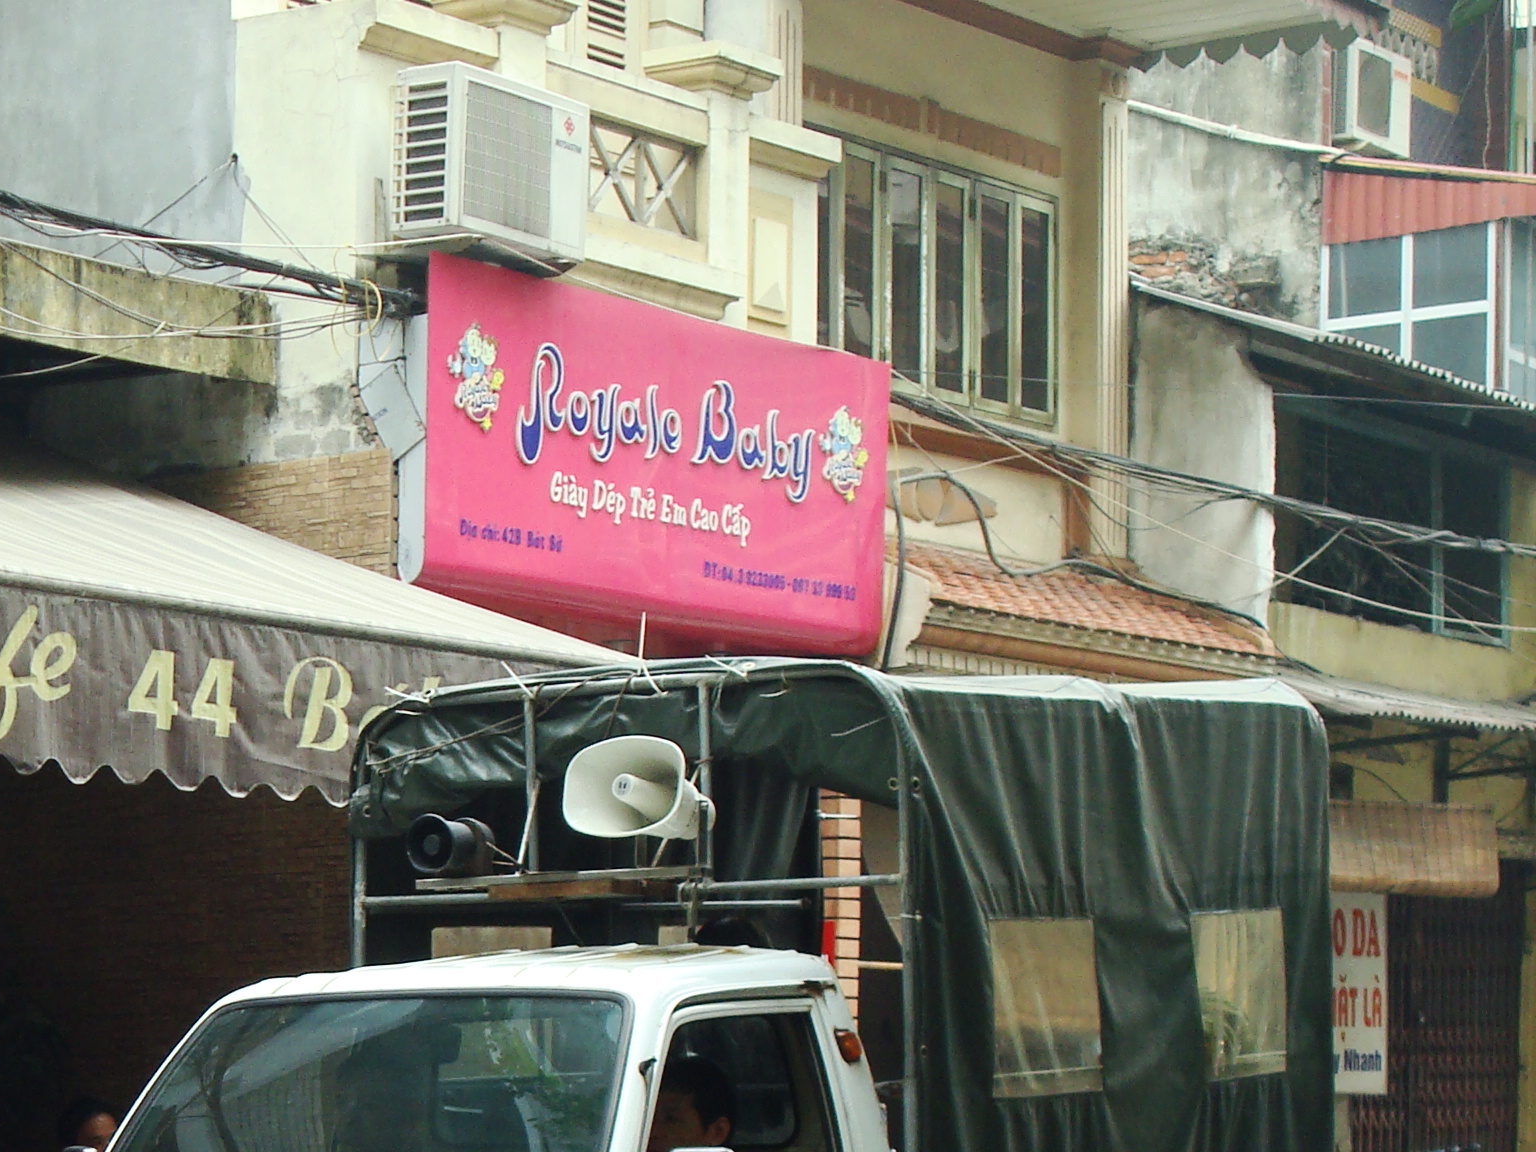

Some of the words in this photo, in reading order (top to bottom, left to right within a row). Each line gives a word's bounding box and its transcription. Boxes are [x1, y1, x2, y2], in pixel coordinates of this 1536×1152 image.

[516, 342, 682, 464] Royale
[690, 380, 816, 503] Baby
[550, 471, 588, 518] Giày
[591, 479, 626, 524] Dép
[630, 486, 657, 520] Trẻ
[660, 494, 687, 526] Em
[690, 498, 719, 532] Cao
[721, 503, 751, 547] Cấp
[128, 649, 239, 738] 44
[1352, 908, 1381, 958] DA
[1363, 973, 1382, 1028] LÀ
[1344, 1048, 1382, 1072] Nhanh
